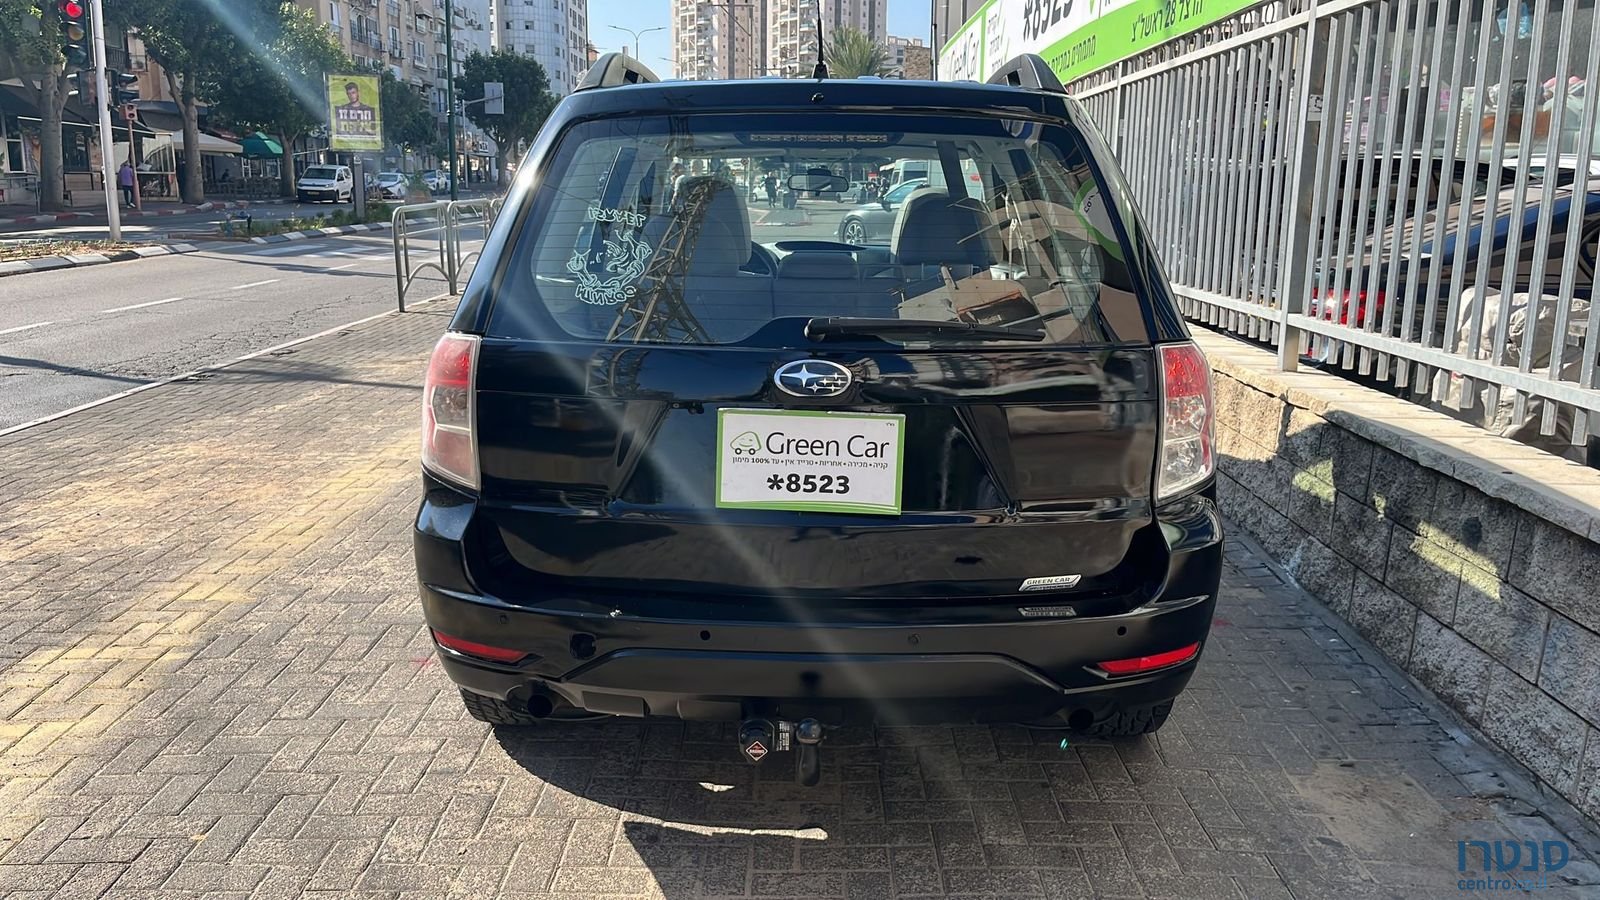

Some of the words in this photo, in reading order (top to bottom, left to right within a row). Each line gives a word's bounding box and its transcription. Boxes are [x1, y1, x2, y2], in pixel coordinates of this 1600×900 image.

[1165, 0, 1176, 28] 28
[766, 431, 839, 457] Green
[847, 434, 890, 458] Car
[732, 456, 750, 464] מימון
[785, 458, 795, 466] אין
[873, 462, 888, 470] קניה
